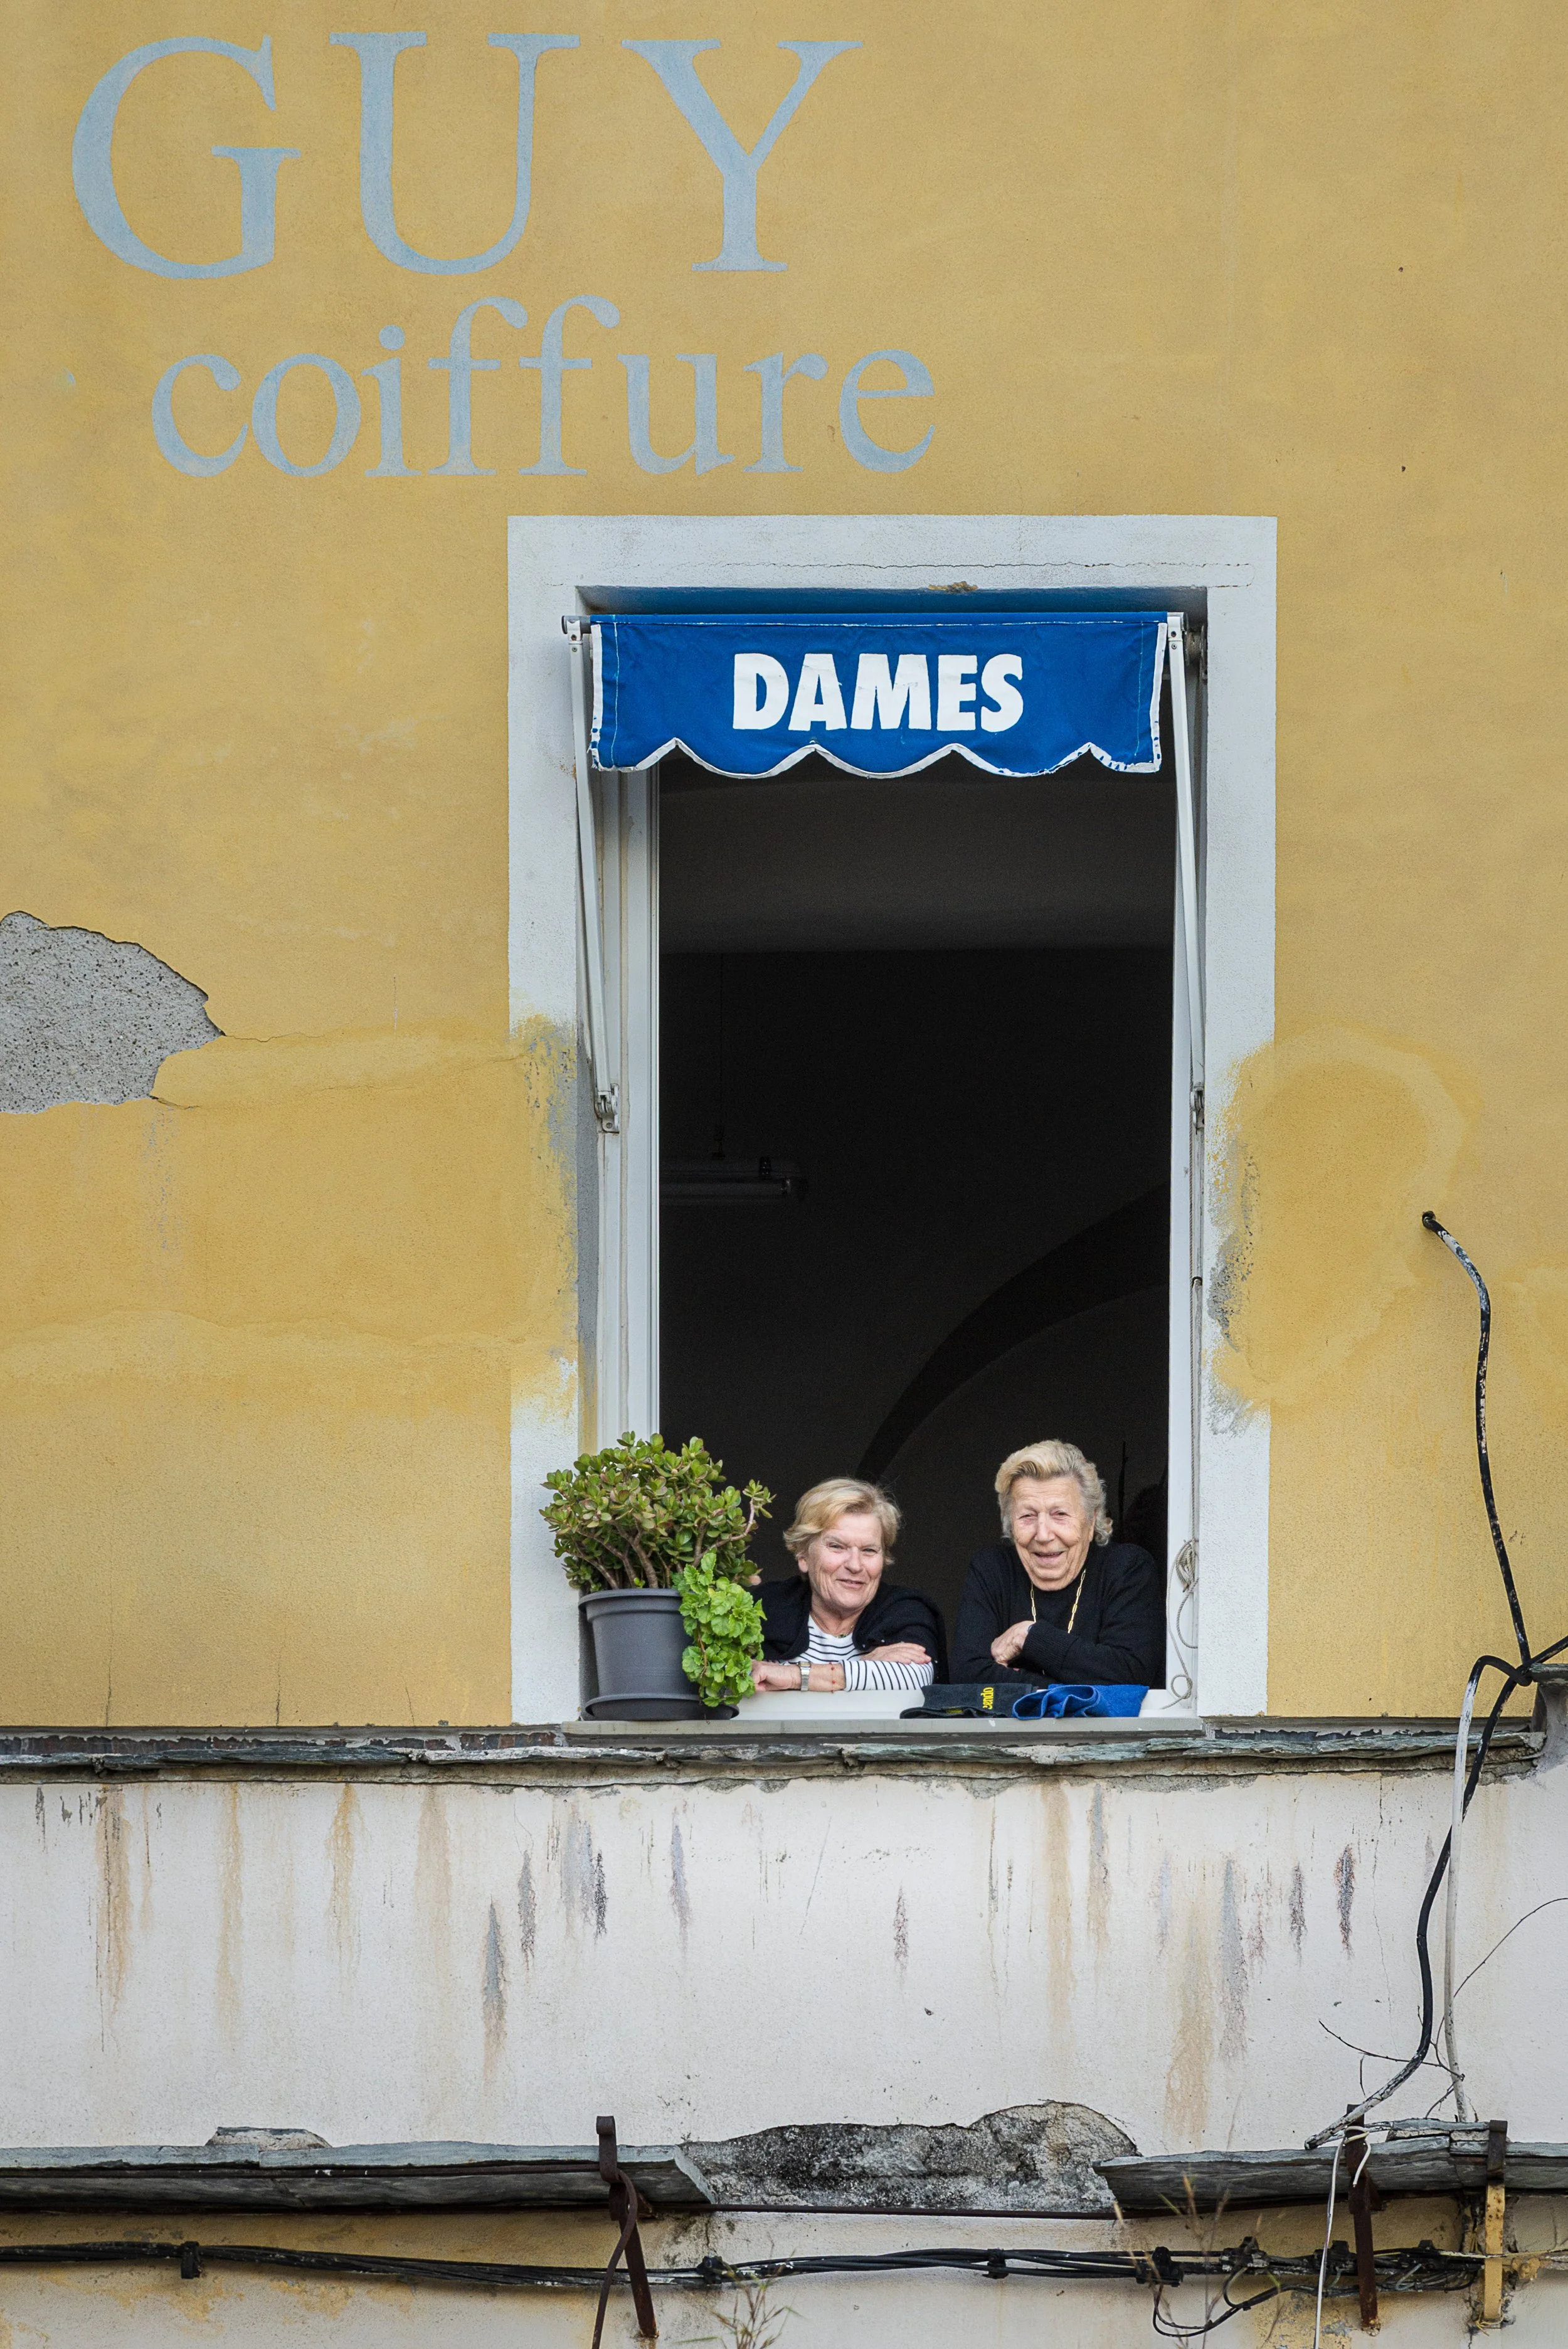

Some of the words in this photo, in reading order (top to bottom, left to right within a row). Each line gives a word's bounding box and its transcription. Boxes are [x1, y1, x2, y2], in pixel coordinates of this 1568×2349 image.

[72, 31, 863, 279] GUY
[151, 294, 935, 477] coiffure
[733, 653, 1023, 733] DAMES
